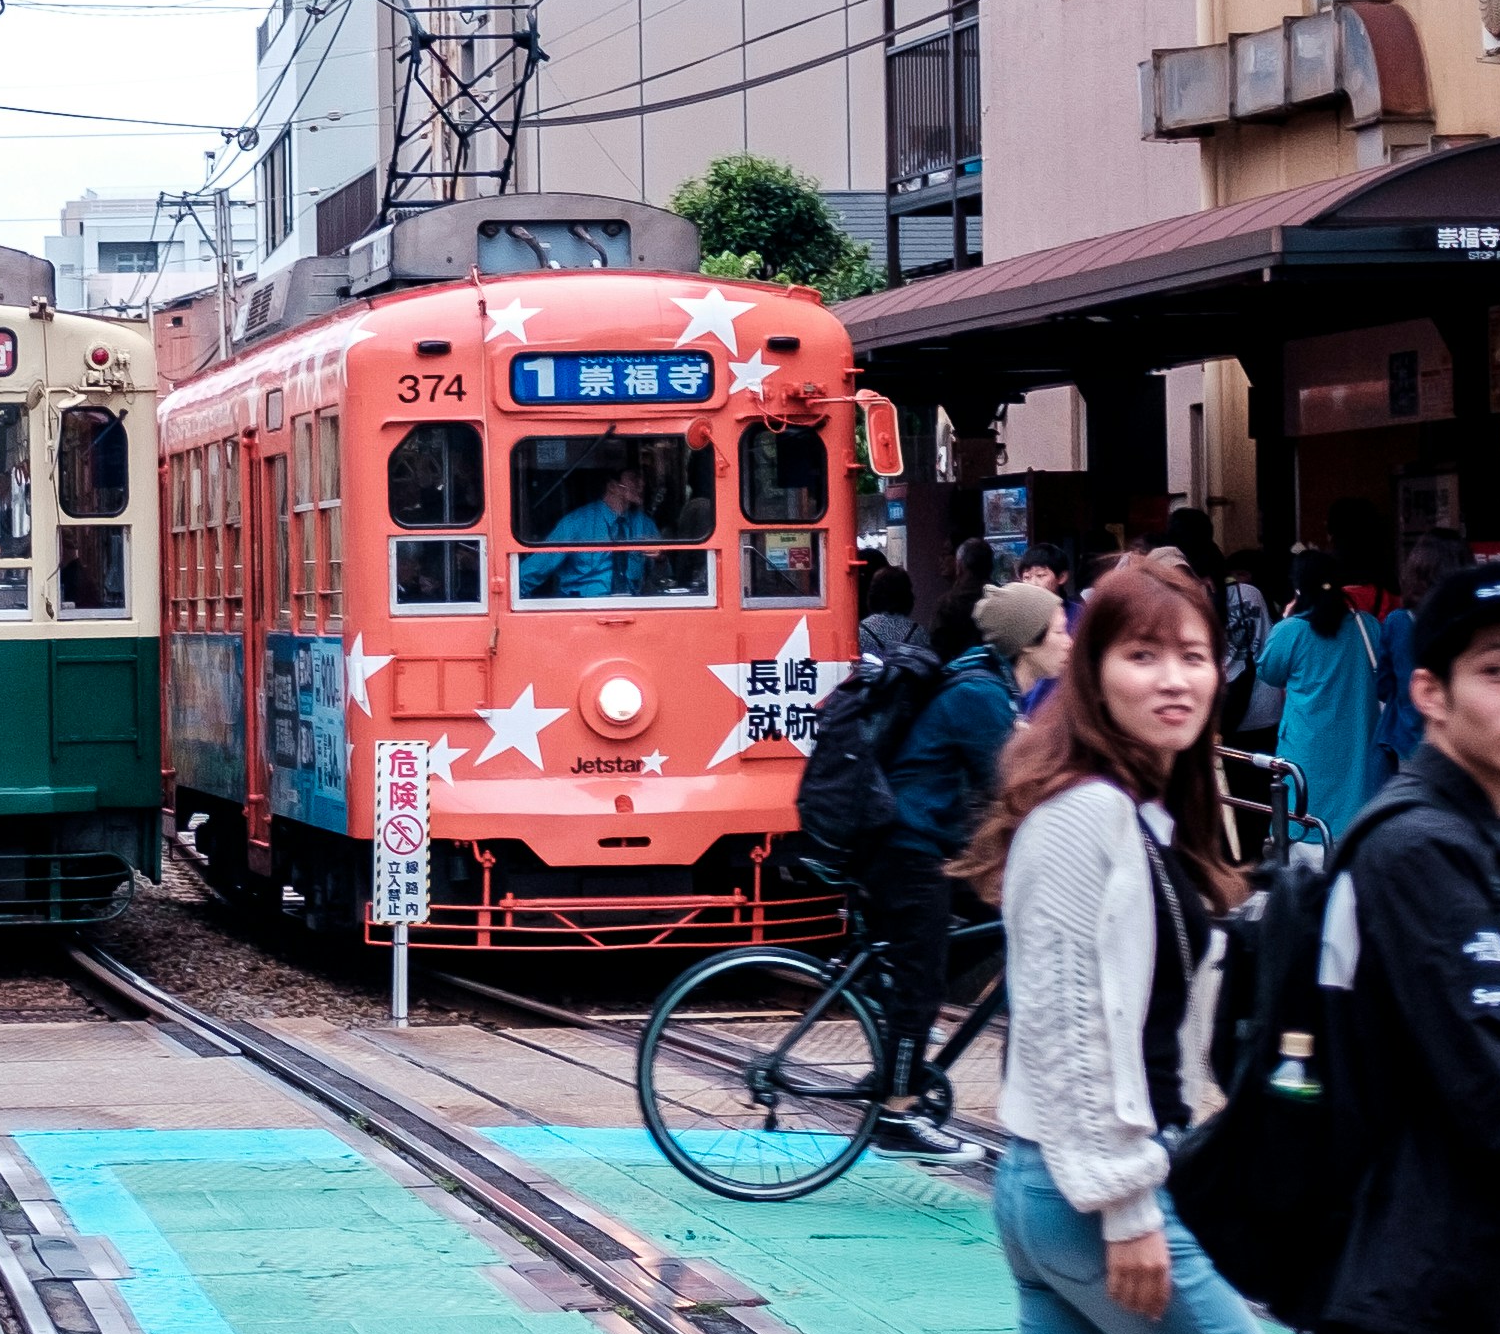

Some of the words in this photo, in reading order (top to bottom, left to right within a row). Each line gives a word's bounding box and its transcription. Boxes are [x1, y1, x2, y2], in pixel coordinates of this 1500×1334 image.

[1468, 251, 1495, 260] STOP
[397, 374, 468, 404] 374
[523, 358, 556, 397] 1
[578, 363, 709, 397] 崇福寺
[747, 658, 818, 696] 長崎
[747, 703, 821, 742] 就航
[389, 749, 419, 811] 危険
[570, 756, 644, 774] Jetstar
[387, 860, 402, 917] 立入禁止
